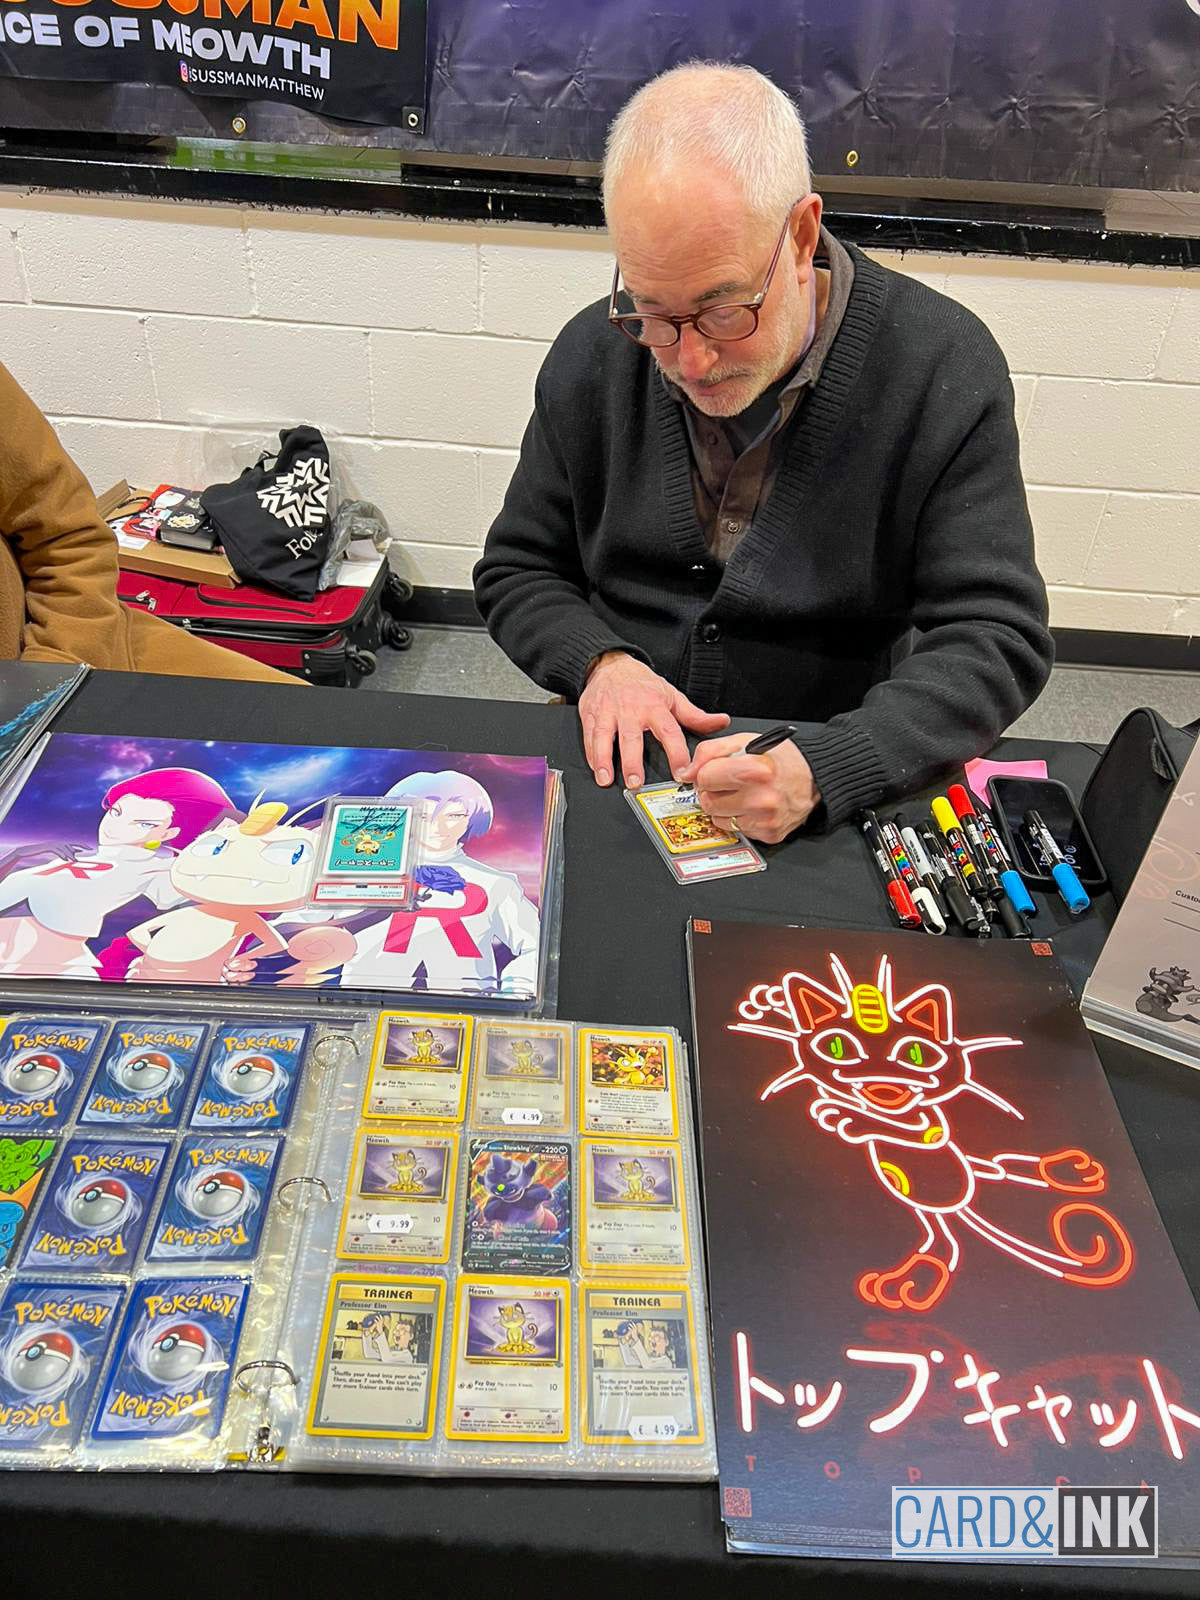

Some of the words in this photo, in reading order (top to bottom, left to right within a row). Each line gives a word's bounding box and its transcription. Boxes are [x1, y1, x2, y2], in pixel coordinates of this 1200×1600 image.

[74, 15, 140, 48] OF
[152, 18, 331, 80] MEOWTH
[390, 1220, 410, 1228] 9.99
[364, 1288, 413, 1300] TRAINER
[612, 1296, 662, 1306] TRAINER
[654, 1424, 675, 1436] 4.99
